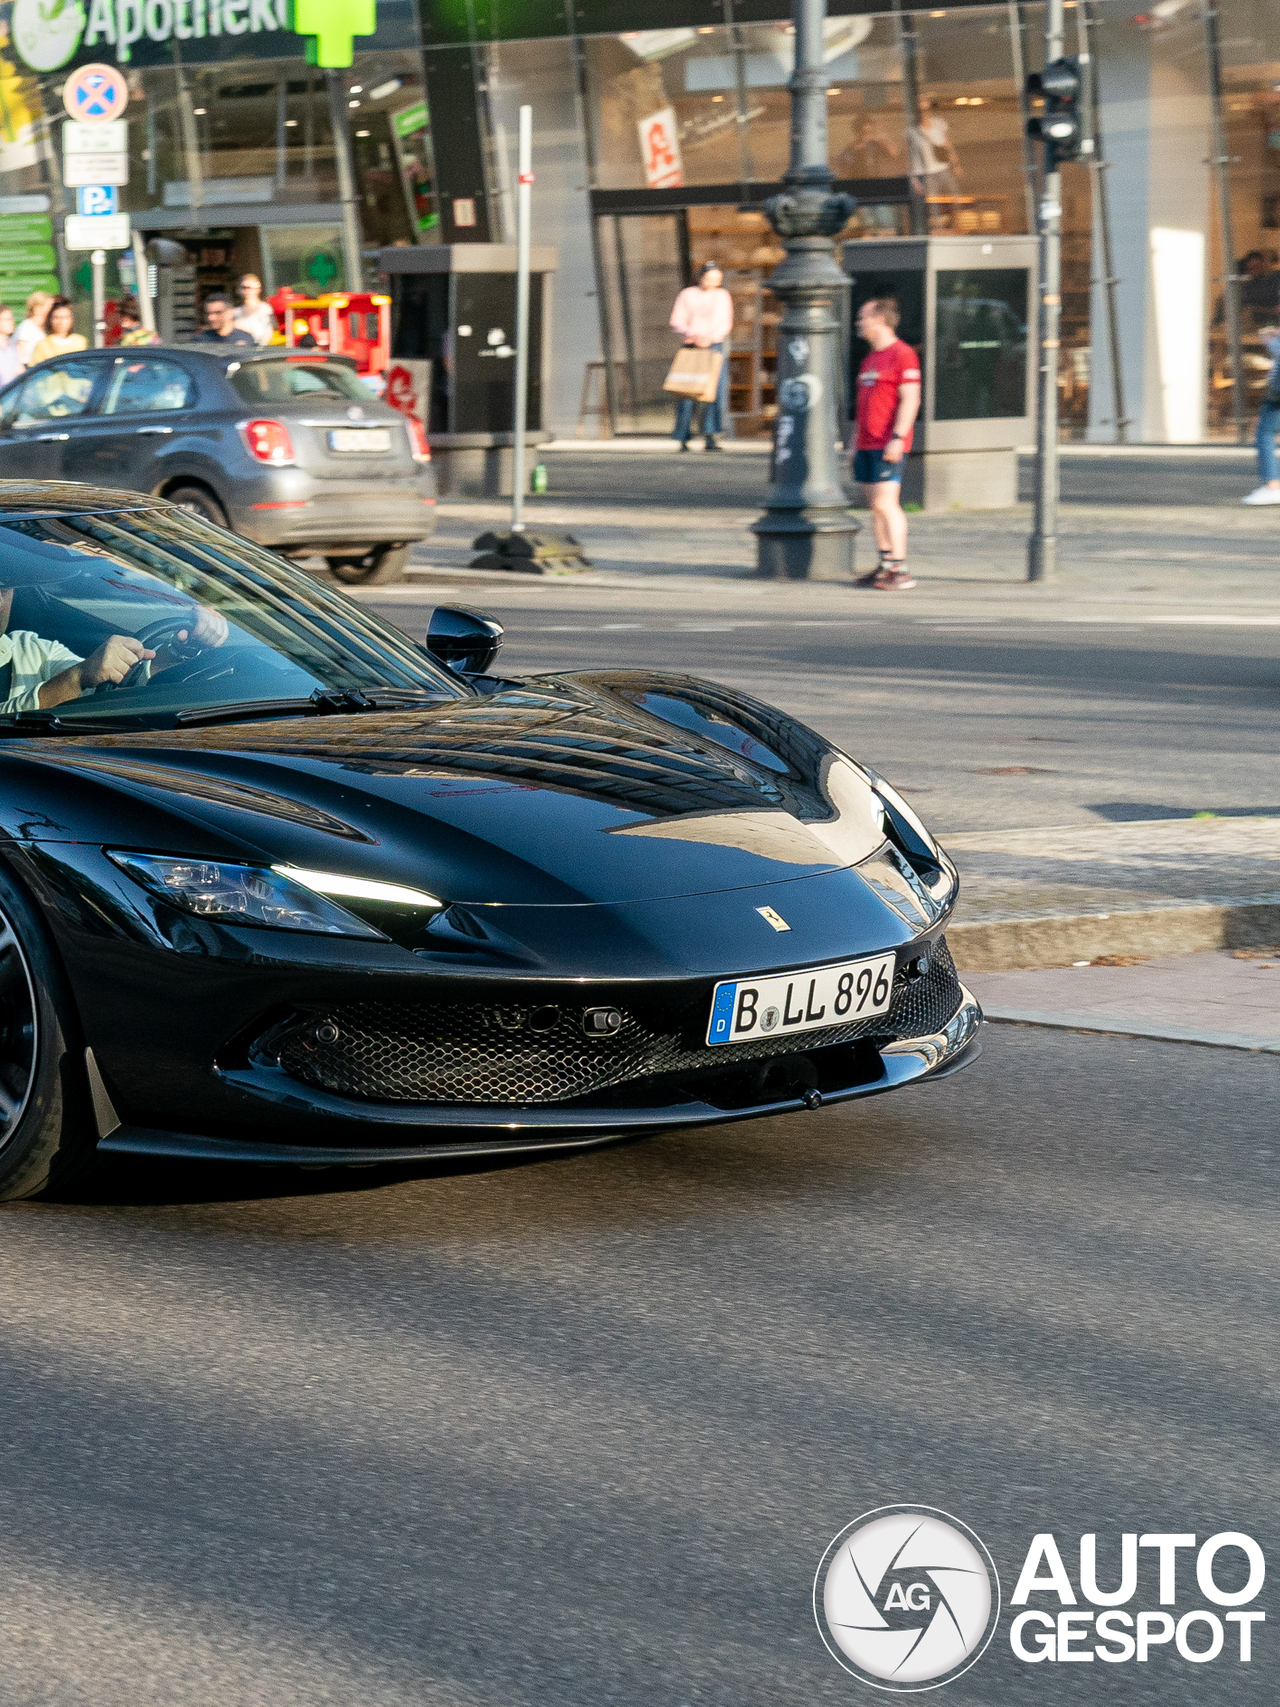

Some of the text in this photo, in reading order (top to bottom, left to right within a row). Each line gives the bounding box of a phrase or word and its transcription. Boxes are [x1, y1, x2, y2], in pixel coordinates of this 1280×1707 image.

[84, 0, 283, 62] Apothek
[83, 186, 107, 215] P
[734, 963, 889, 1033] B LL 896
[716, 1019, 726, 1033] D
